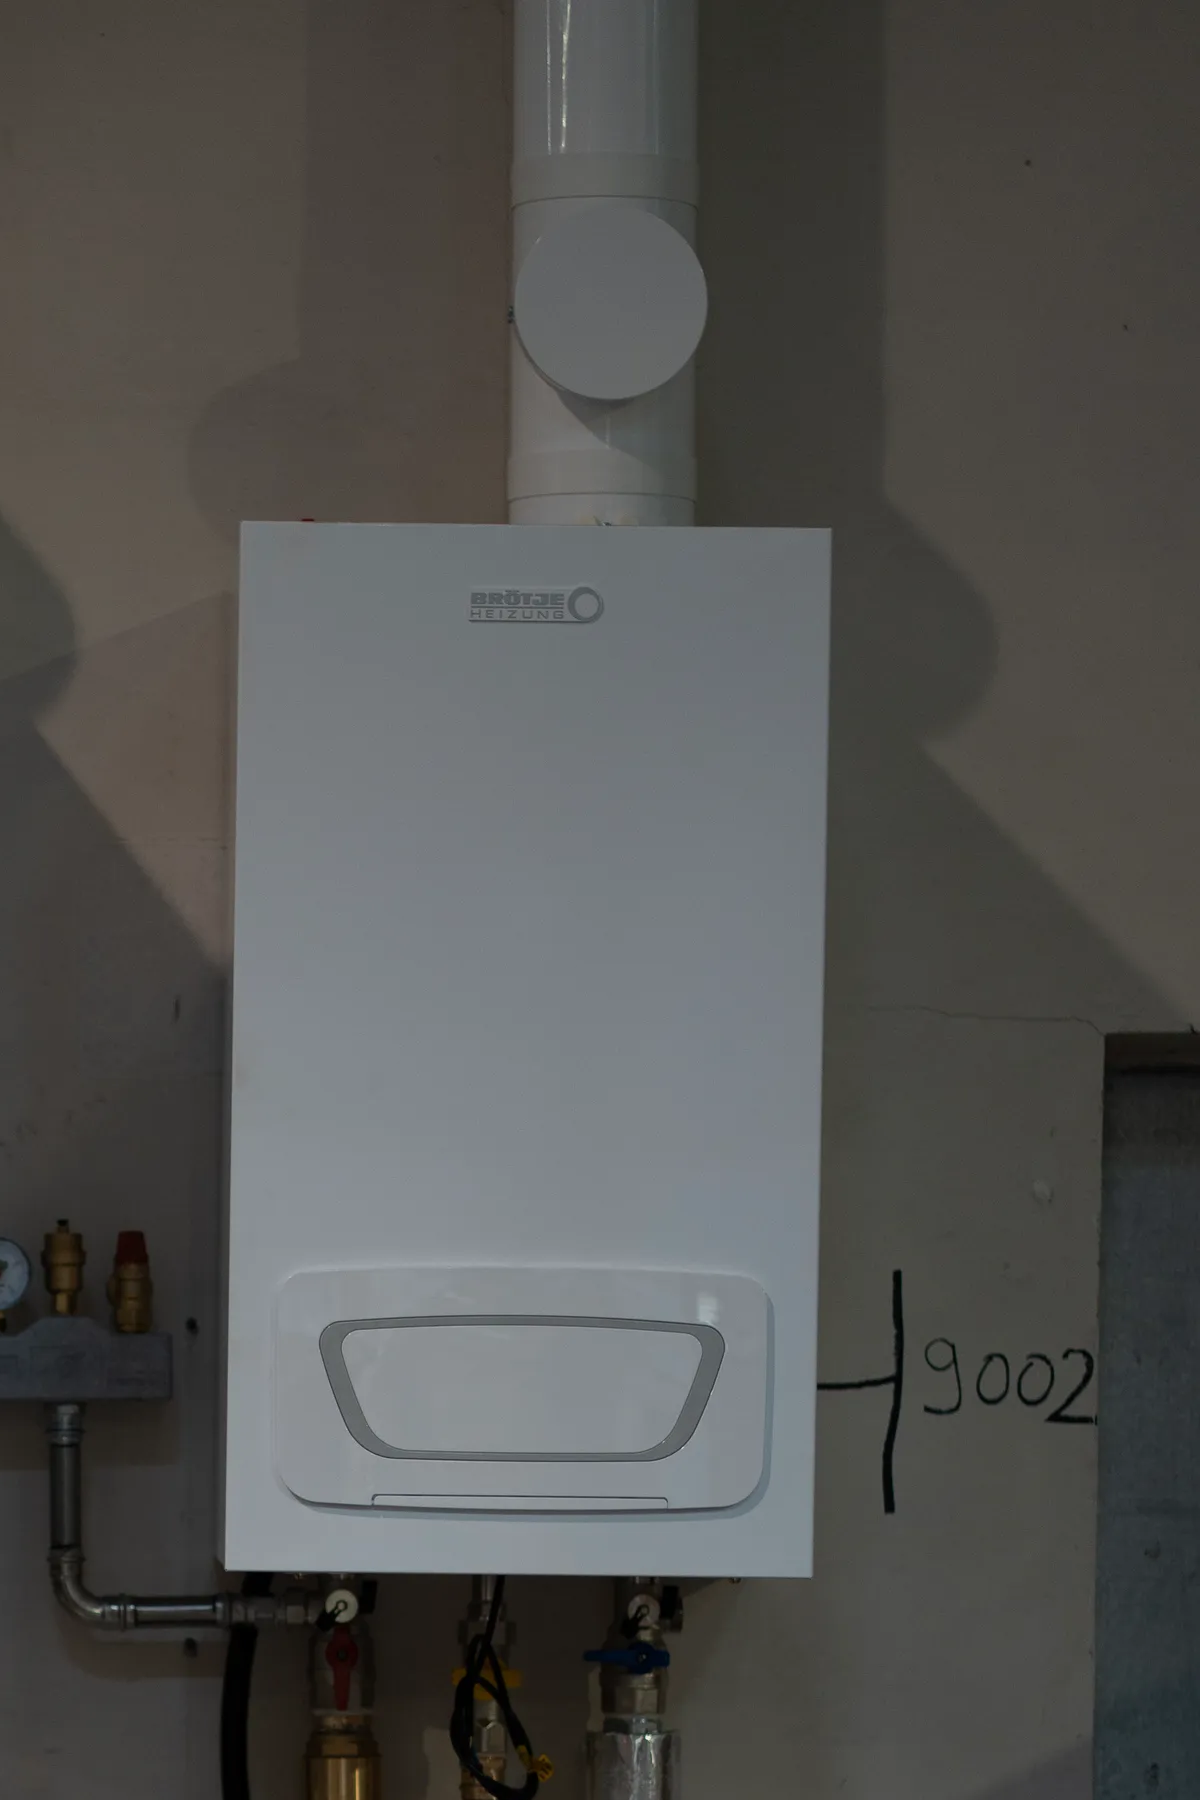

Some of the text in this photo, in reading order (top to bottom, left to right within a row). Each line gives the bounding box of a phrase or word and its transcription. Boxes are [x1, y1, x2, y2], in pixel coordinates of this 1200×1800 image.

[470, 590, 565, 605] BRÖTJE
[470, 610, 564, 619] HEIZUNG
[924, 1337, 1096, 1424] 9002
